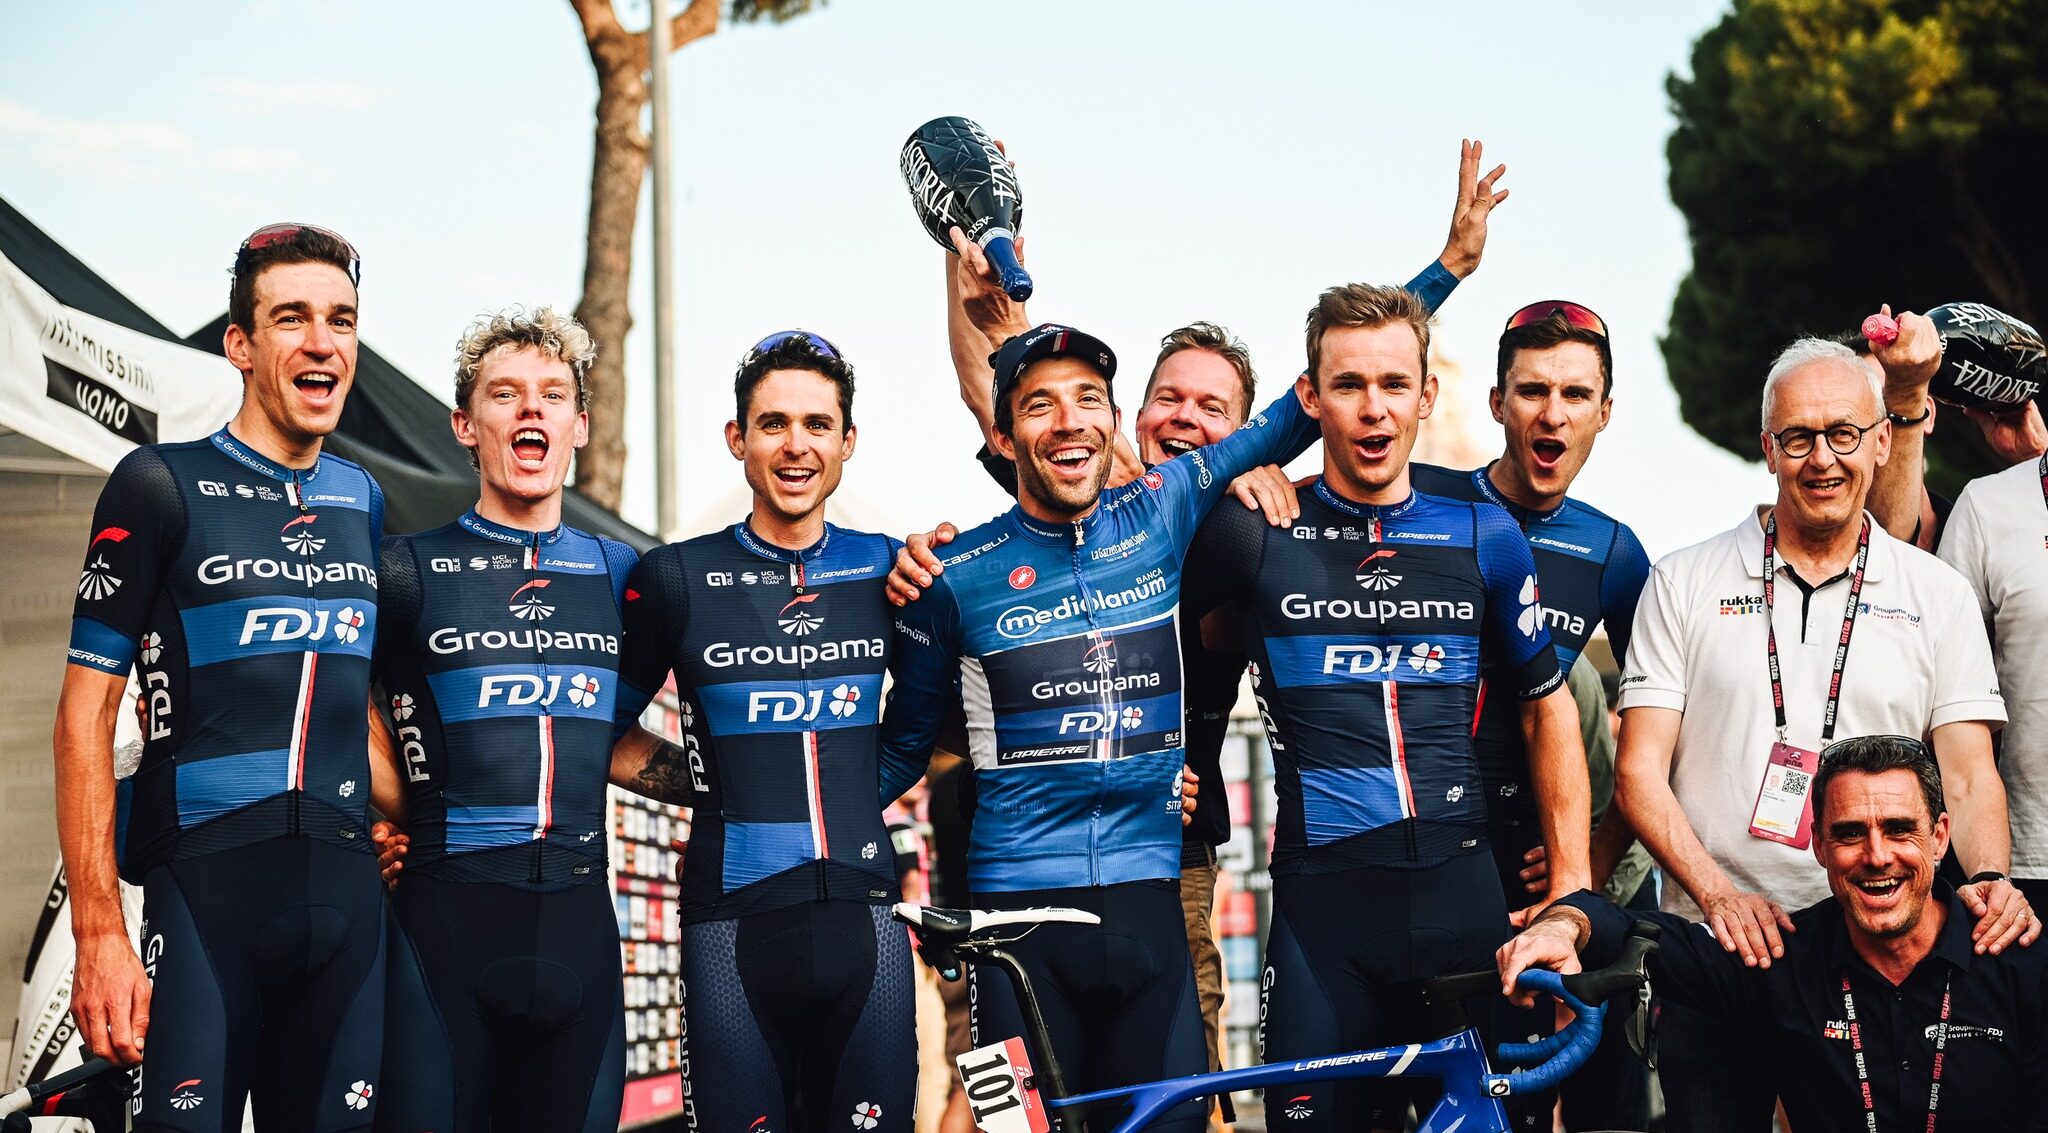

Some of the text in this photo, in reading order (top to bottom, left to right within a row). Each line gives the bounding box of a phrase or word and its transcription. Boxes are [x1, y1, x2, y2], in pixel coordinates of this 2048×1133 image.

[902, 139, 957, 224] ASTORIA
[1952, 359, 2040, 405] ASTORIA
[76, 380, 129, 430] UOMO
[222, 442, 276, 476] Groupama
[308, 495, 357, 503] LAPIERRE
[472, 523, 523, 544] Groupama
[741, 531, 778, 559] Groupama
[1387, 531, 1452, 541] LAPIERRE
[1529, 536, 1593, 554] LAPIERRE
[197, 554, 378, 590] Groupama
[544, 558, 597, 569] LAPIERRE
[811, 565, 876, 580] LAPIERRE
[1136, 568, 1163, 585] BANCA
[1004, 576, 1167, 632] mediolanum
[1280, 593, 1474, 624] Groupama
[1720, 594, 1763, 606] rukka
[239, 607, 330, 645] FDJ
[428, 627, 619, 655] Groupama
[895, 619, 930, 647] olanum
[703, 638, 885, 669] Groupama
[1323, 644, 1403, 675] FDJ
[478, 674, 562, 708] FDJ
[1032, 672, 1161, 700] Groupama
[147, 671, 172, 742] FDJ
[748, 689, 825, 723] FDJ
[1059, 710, 1119, 735] FDJ
[398, 726, 430, 783] FDJ
[685, 734, 710, 792] FDJ
[1002, 744, 1091, 760] LAPIERRE
[1987, 1027, 2003, 1037] FDJ
[678, 978, 698, 1133] Groupam
[1294, 1051, 1389, 1072] LAPIERRE
[959, 1053, 1021, 1124] 101
